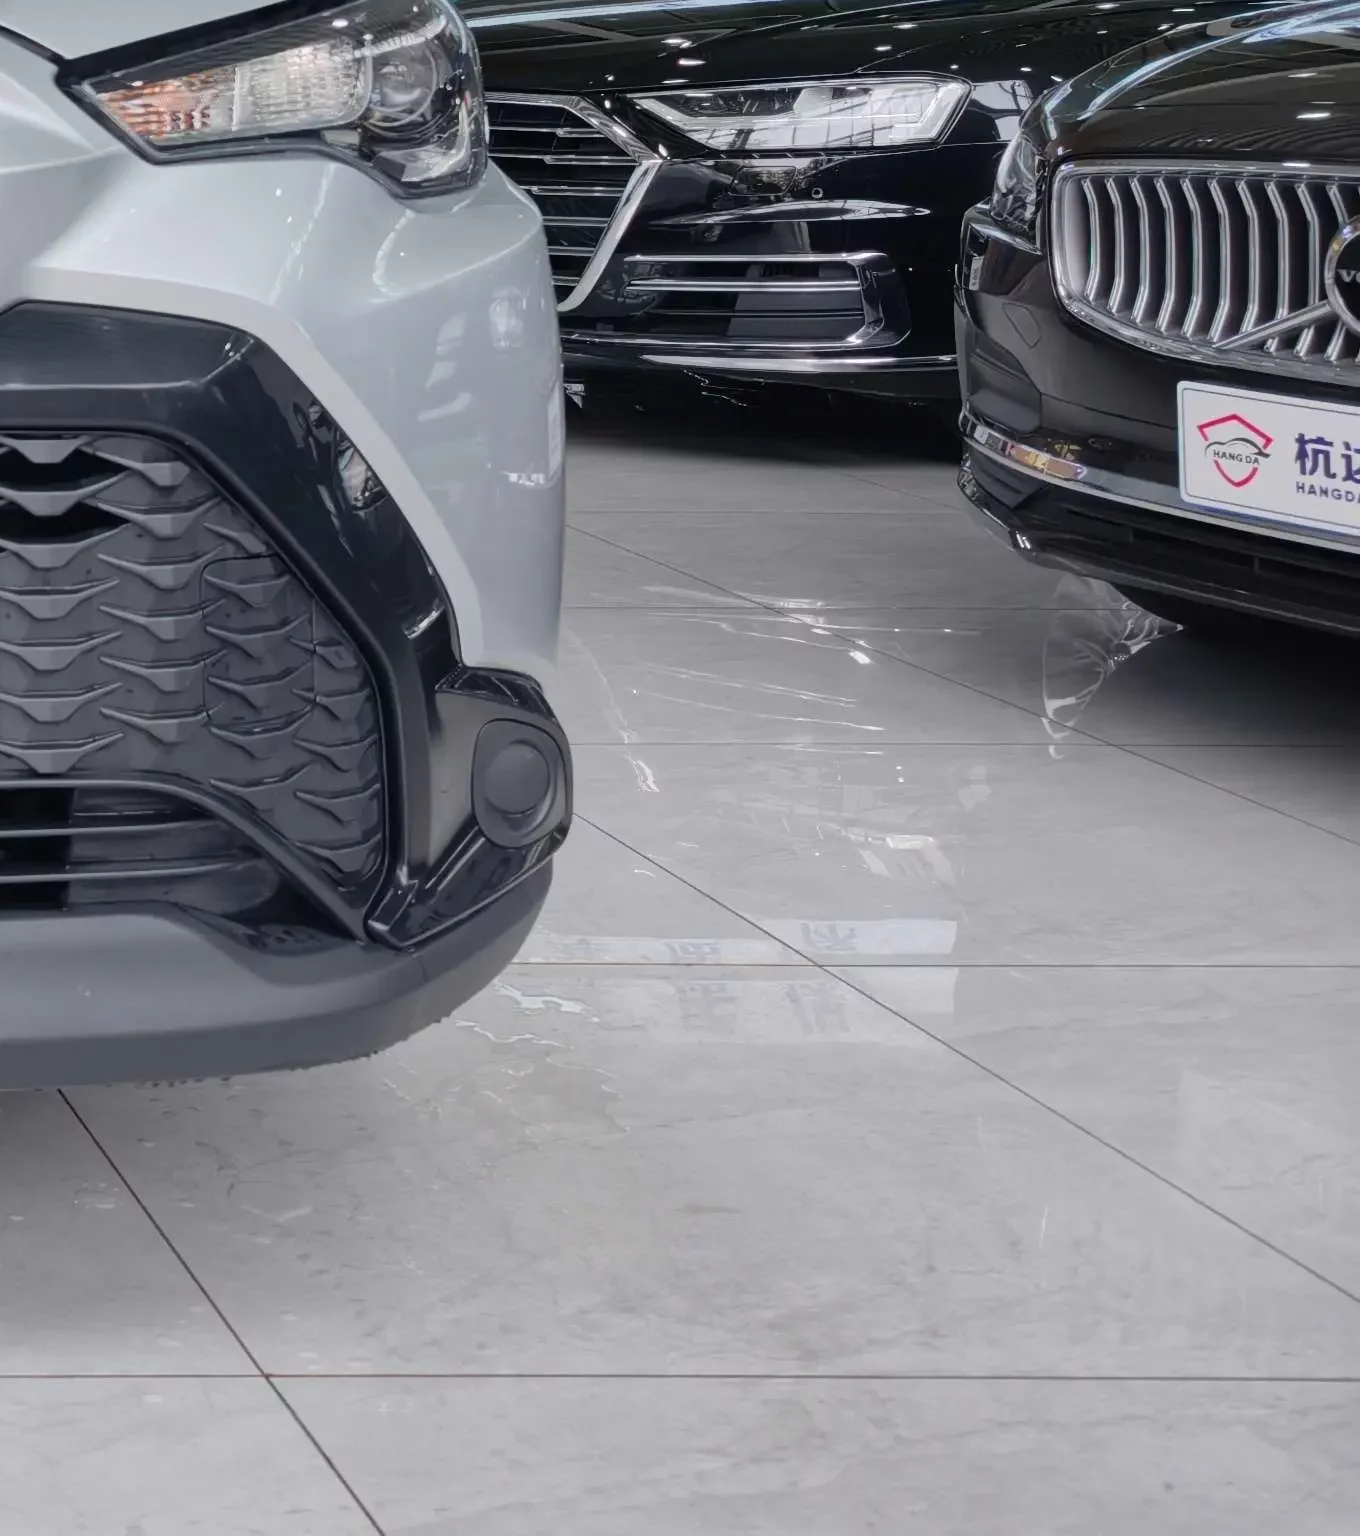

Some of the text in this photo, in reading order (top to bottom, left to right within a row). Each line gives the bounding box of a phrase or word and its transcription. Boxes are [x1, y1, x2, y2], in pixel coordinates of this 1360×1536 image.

[1213, 449, 1260, 465] HANG DA
[1296, 480, 1360, 504] HANGD
